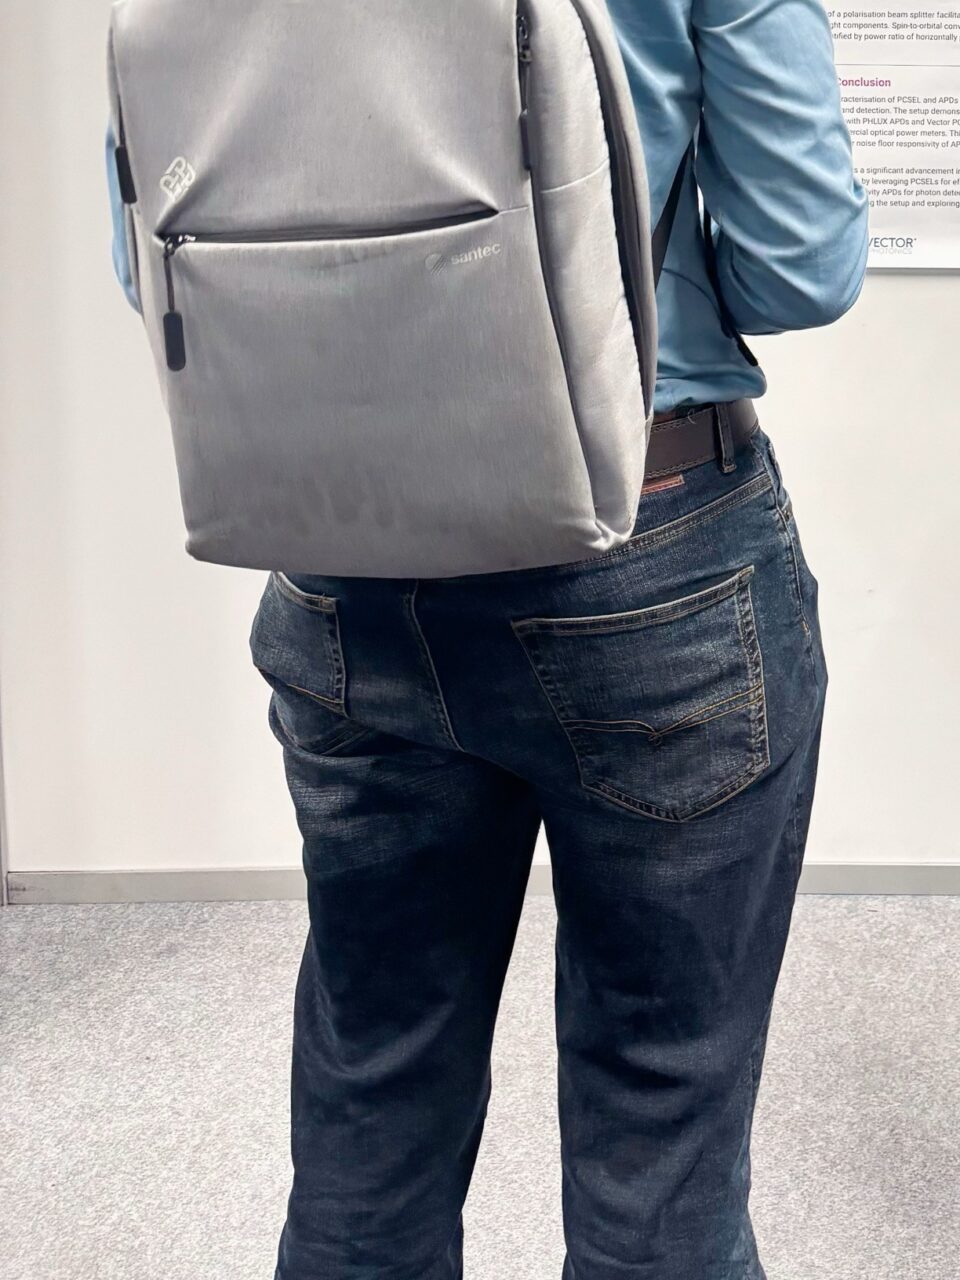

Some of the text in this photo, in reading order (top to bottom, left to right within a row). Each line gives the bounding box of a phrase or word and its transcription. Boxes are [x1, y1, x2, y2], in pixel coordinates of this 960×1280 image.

[828, 10, 836, 20] of
[910, 11, 935, 19] splitter
[861, 178, 870, 187] by
[872, 178, 909, 187] leveraging
[915, 189, 941, 197] photon
[926, 200, 960, 209] exploring
[450, 243, 501, 264] santec
